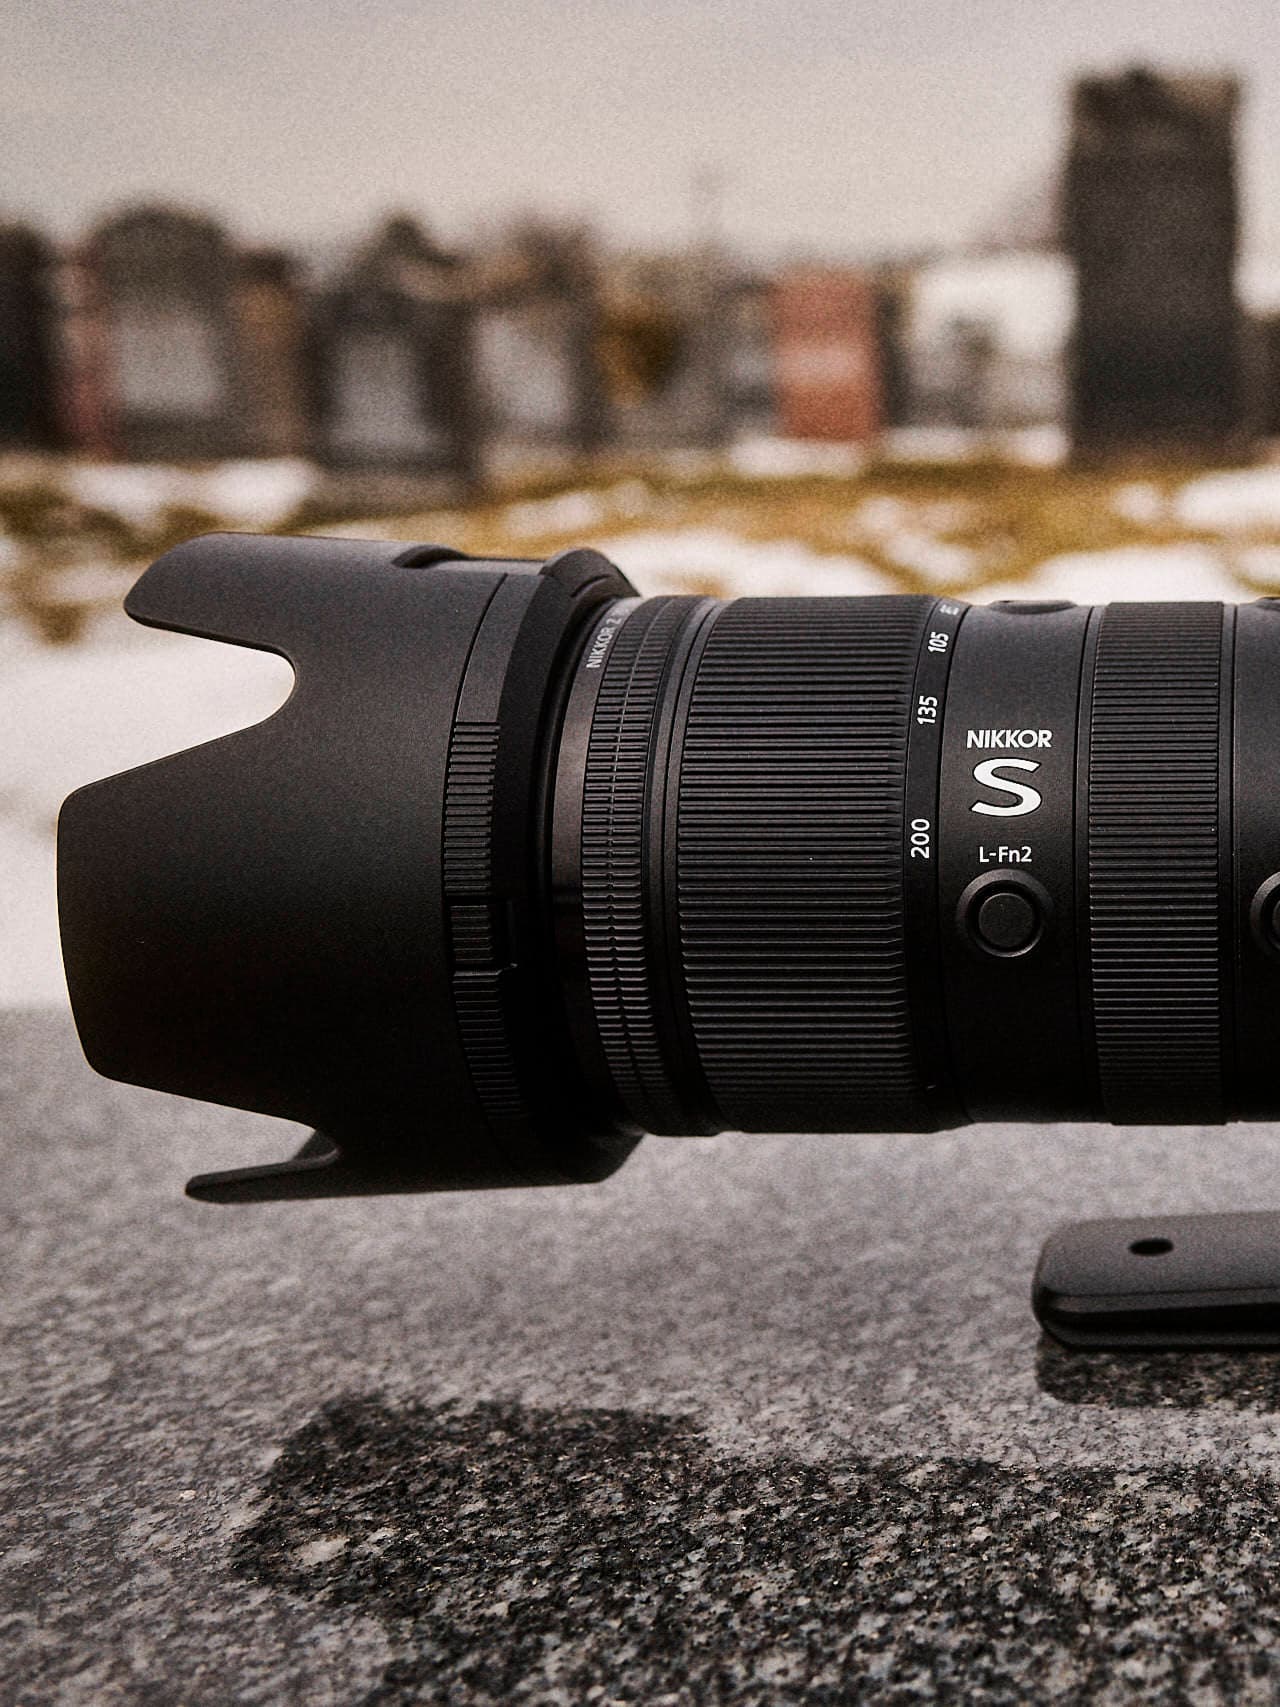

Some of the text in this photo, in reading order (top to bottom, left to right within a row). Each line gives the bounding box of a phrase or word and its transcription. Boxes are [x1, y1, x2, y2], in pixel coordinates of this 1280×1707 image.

[586, 626, 615, 669] NIKKOR
[927, 631, 949, 654] 105
[917, 695, 938, 725] 135
[966, 729, 1054, 749] NIKKOR
[969, 757, 1043, 817] S
[910, 818, 930, 859] 200
[979, 846, 1033, 863] L-Fn2
